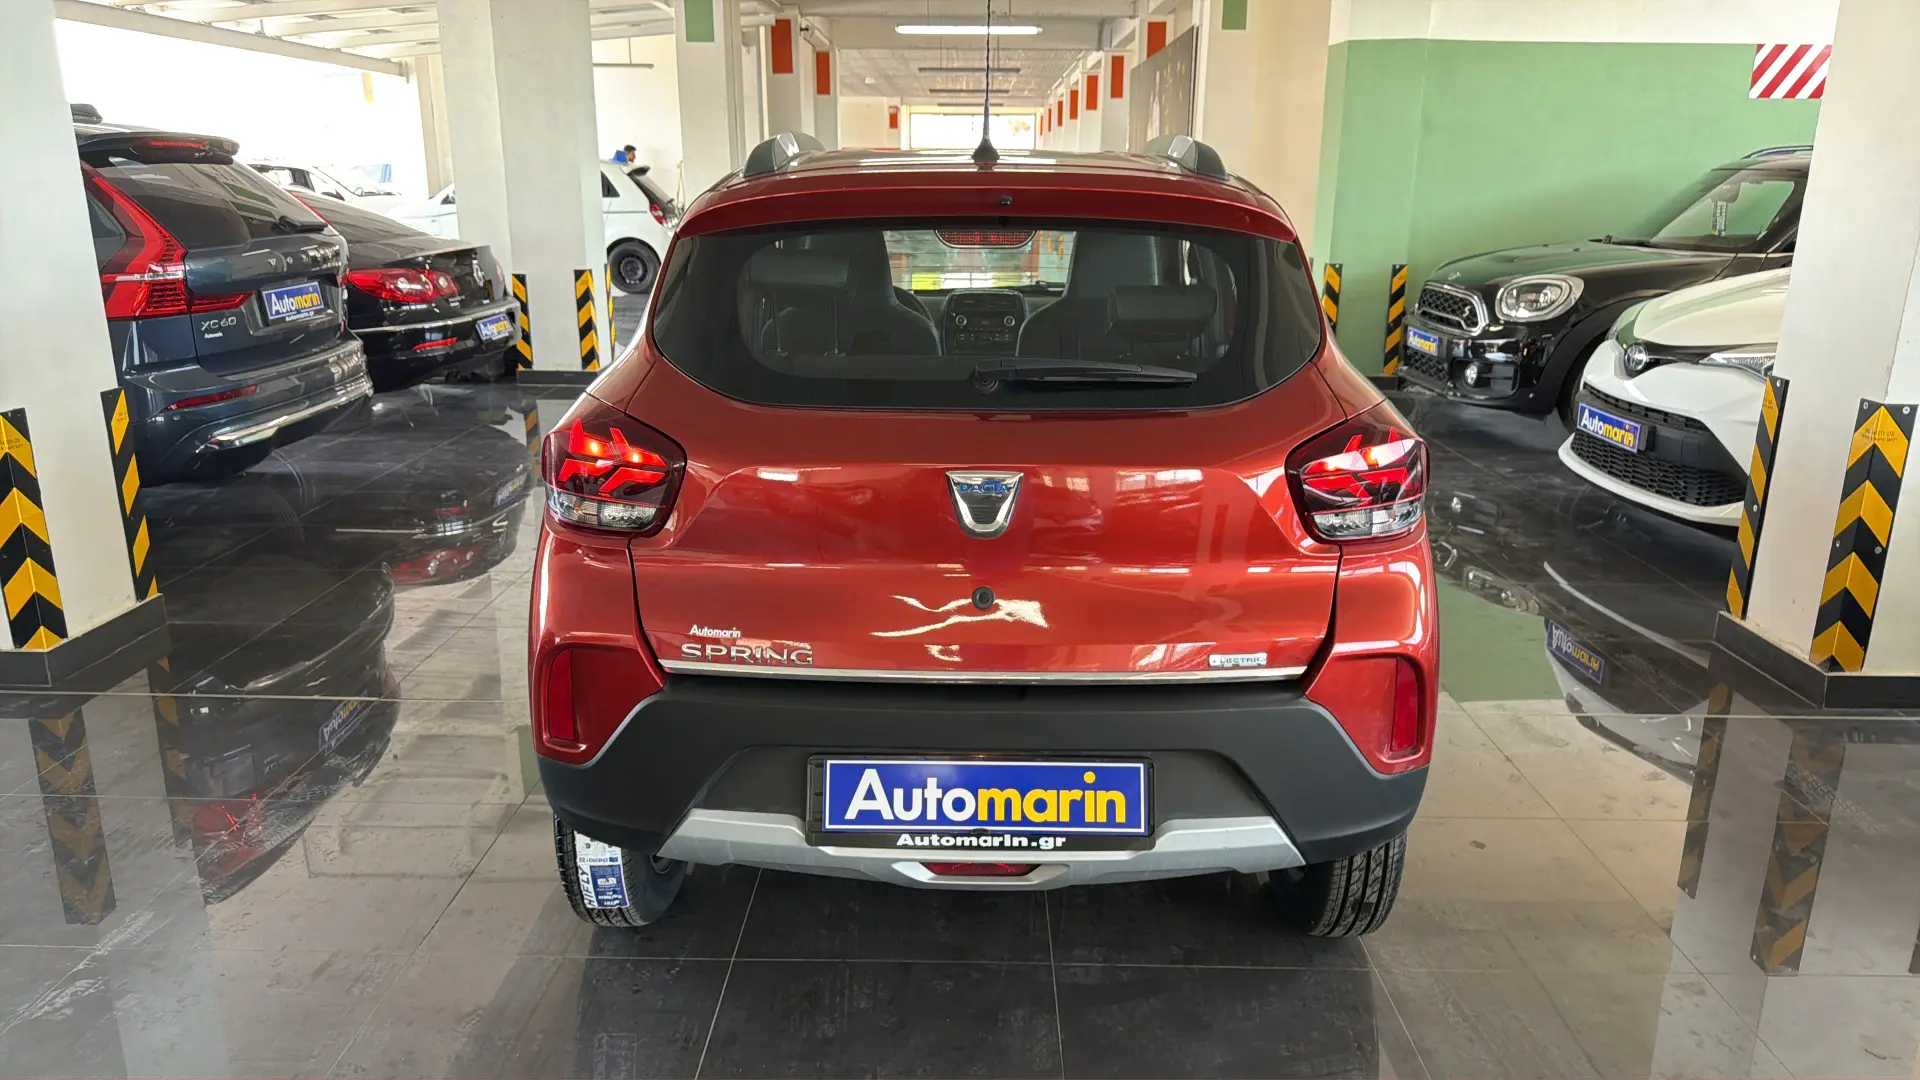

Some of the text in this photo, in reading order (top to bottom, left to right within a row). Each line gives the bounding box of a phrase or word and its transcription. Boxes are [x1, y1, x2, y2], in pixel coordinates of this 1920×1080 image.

[271, 286, 321, 315] Automarin
[1580, 408, 1635, 448] Automarin
[689, 624, 741, 638] Automarin
[681, 643, 813, 665] SPRING
[844, 768, 1126, 823] Automarin
[896, 834, 1066, 849] Automarin.gr
[579, 864, 596, 907] HIFLY
